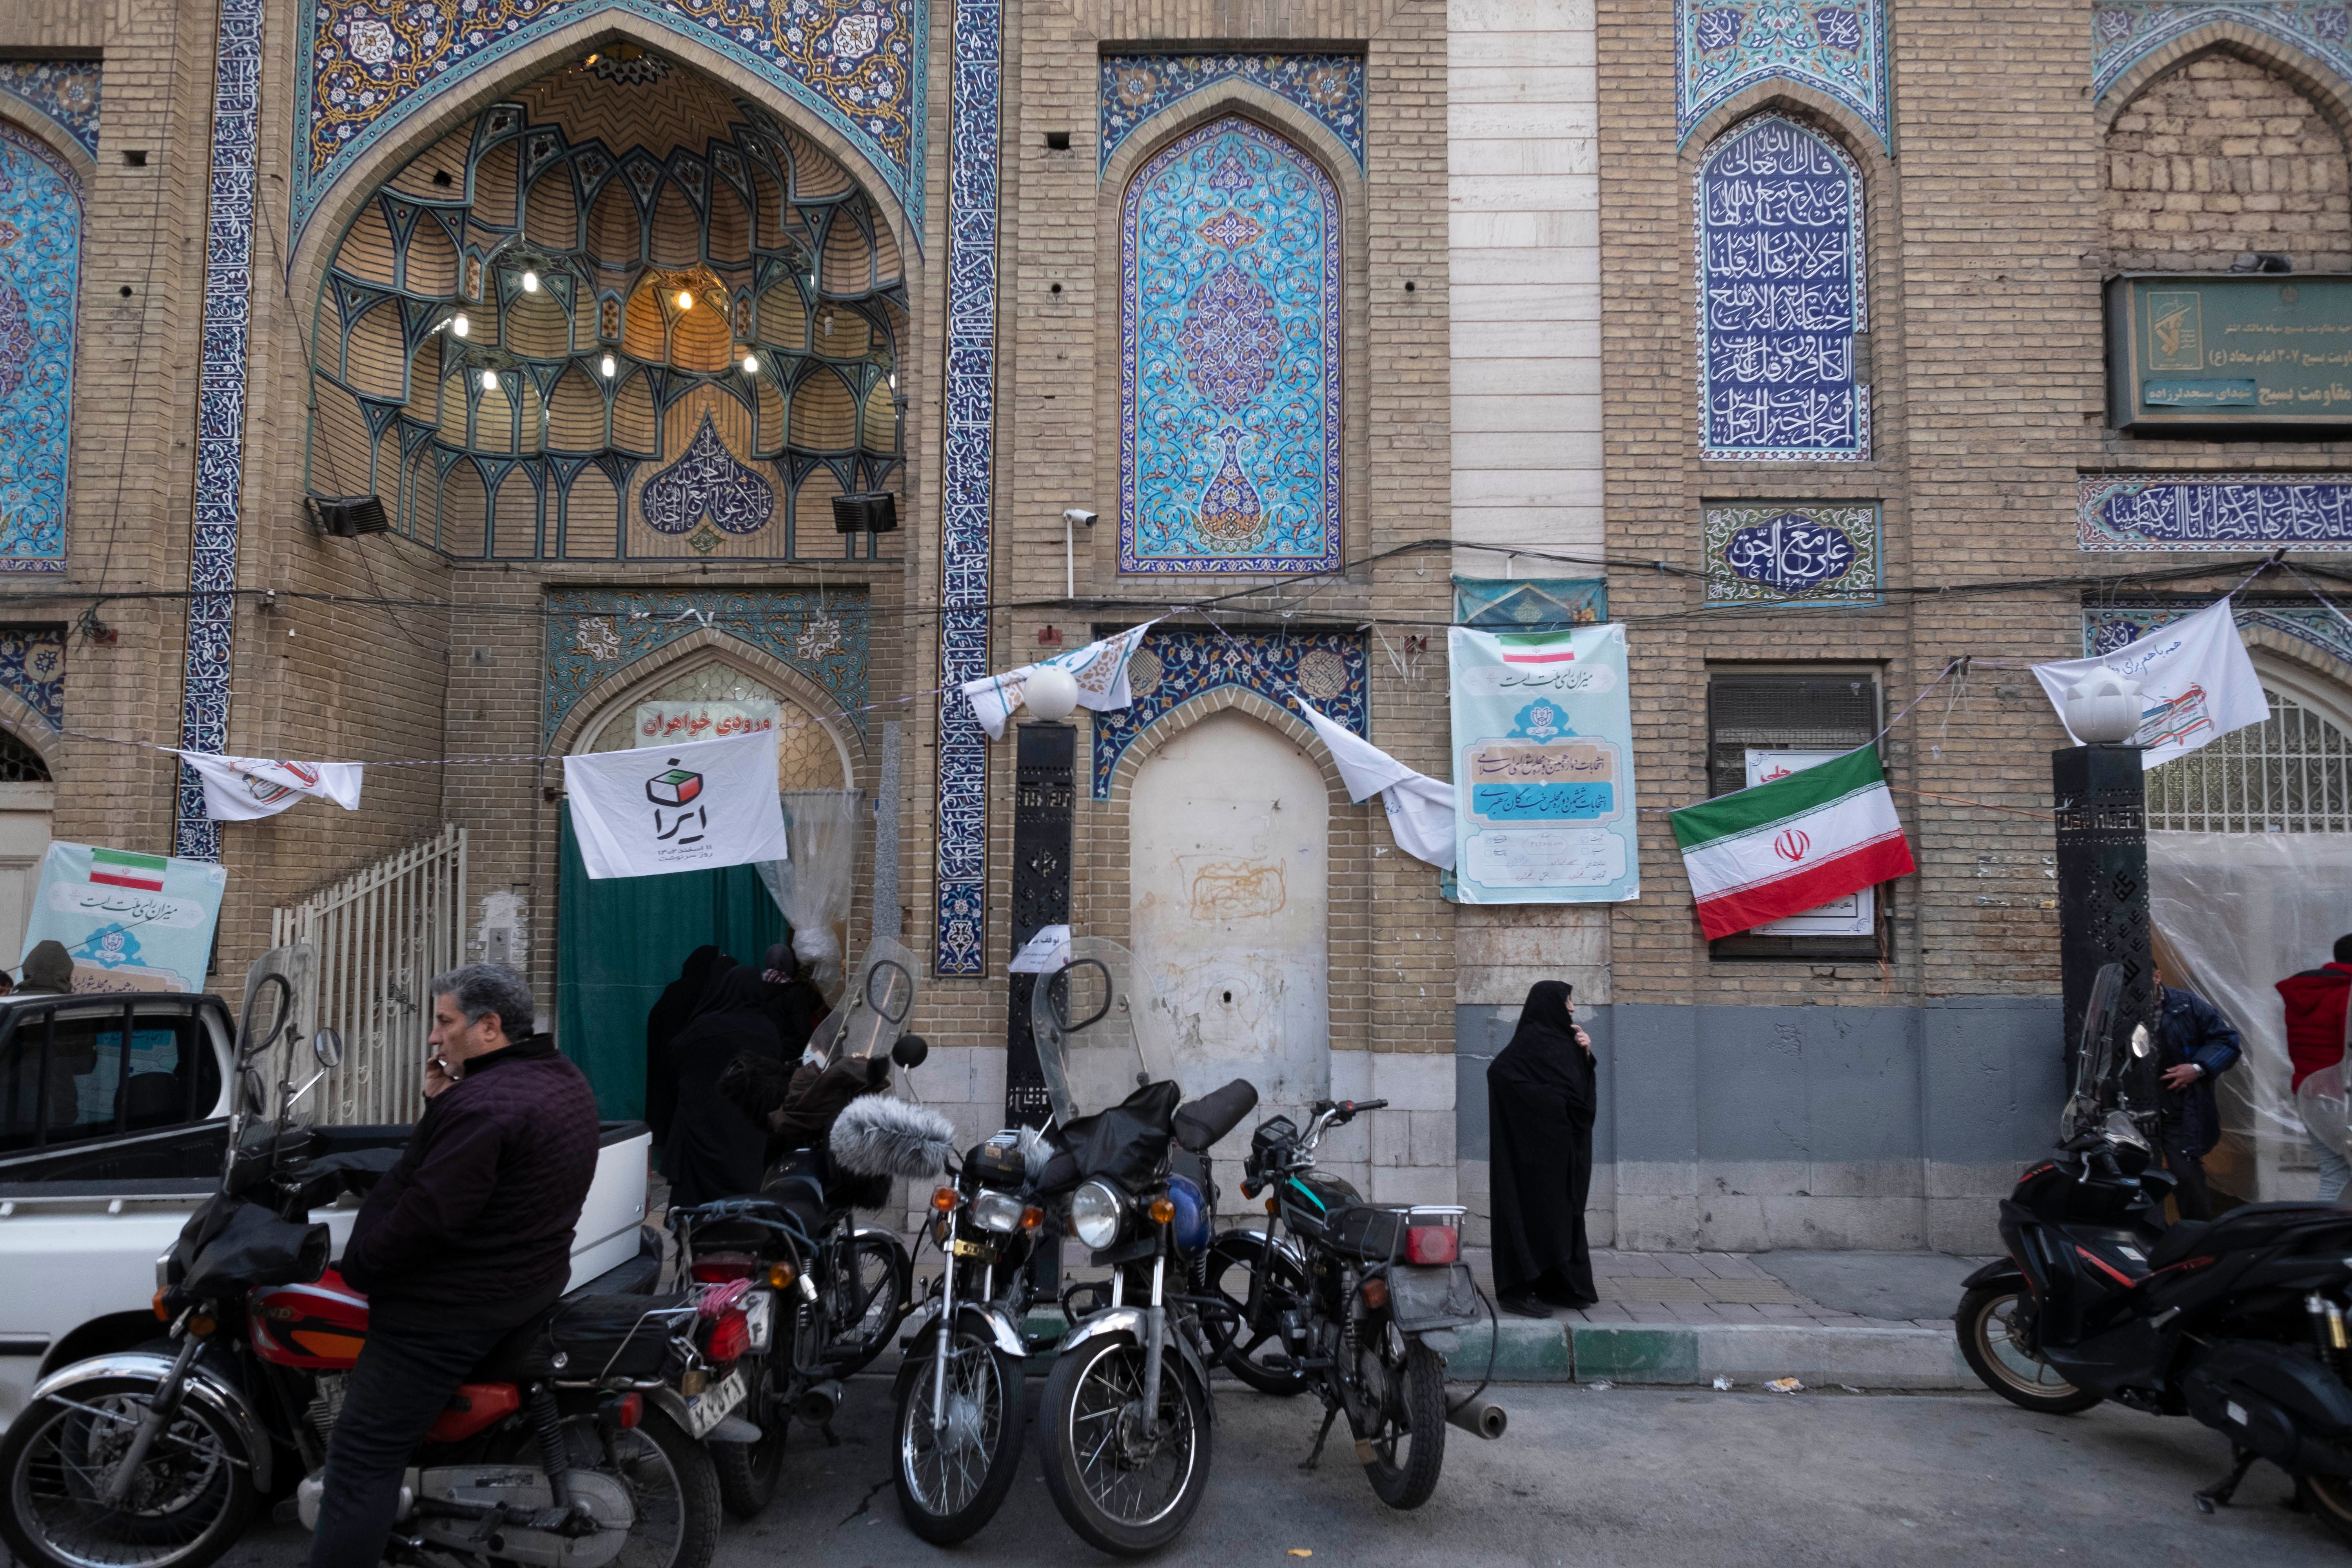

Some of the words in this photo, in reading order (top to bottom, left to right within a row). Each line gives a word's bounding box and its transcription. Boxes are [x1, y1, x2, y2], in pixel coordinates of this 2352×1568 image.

[1720, 134, 1777, 176] تعالى
[2258, 387, 2294, 406] بسیج
[1499, 671, 1530, 687] است
[1567, 670, 1593, 689] میزان
[642, 711, 712, 737] خواهران
[715, 714, 771, 736] ورودی
[1477, 753, 1515, 775] اسلامی
[1575, 757, 1604, 774] انتخابات
[1480, 788, 1509, 815] رهبری
[1503, 787, 1547, 814] خبرگان
[1575, 794, 1606, 812] انتخابات
[658, 853, 697, 862] سرنوشت
[679, 845, 704, 854] اسفند
[80, 894, 111, 907] است
[145, 902, 178, 920] میزان
